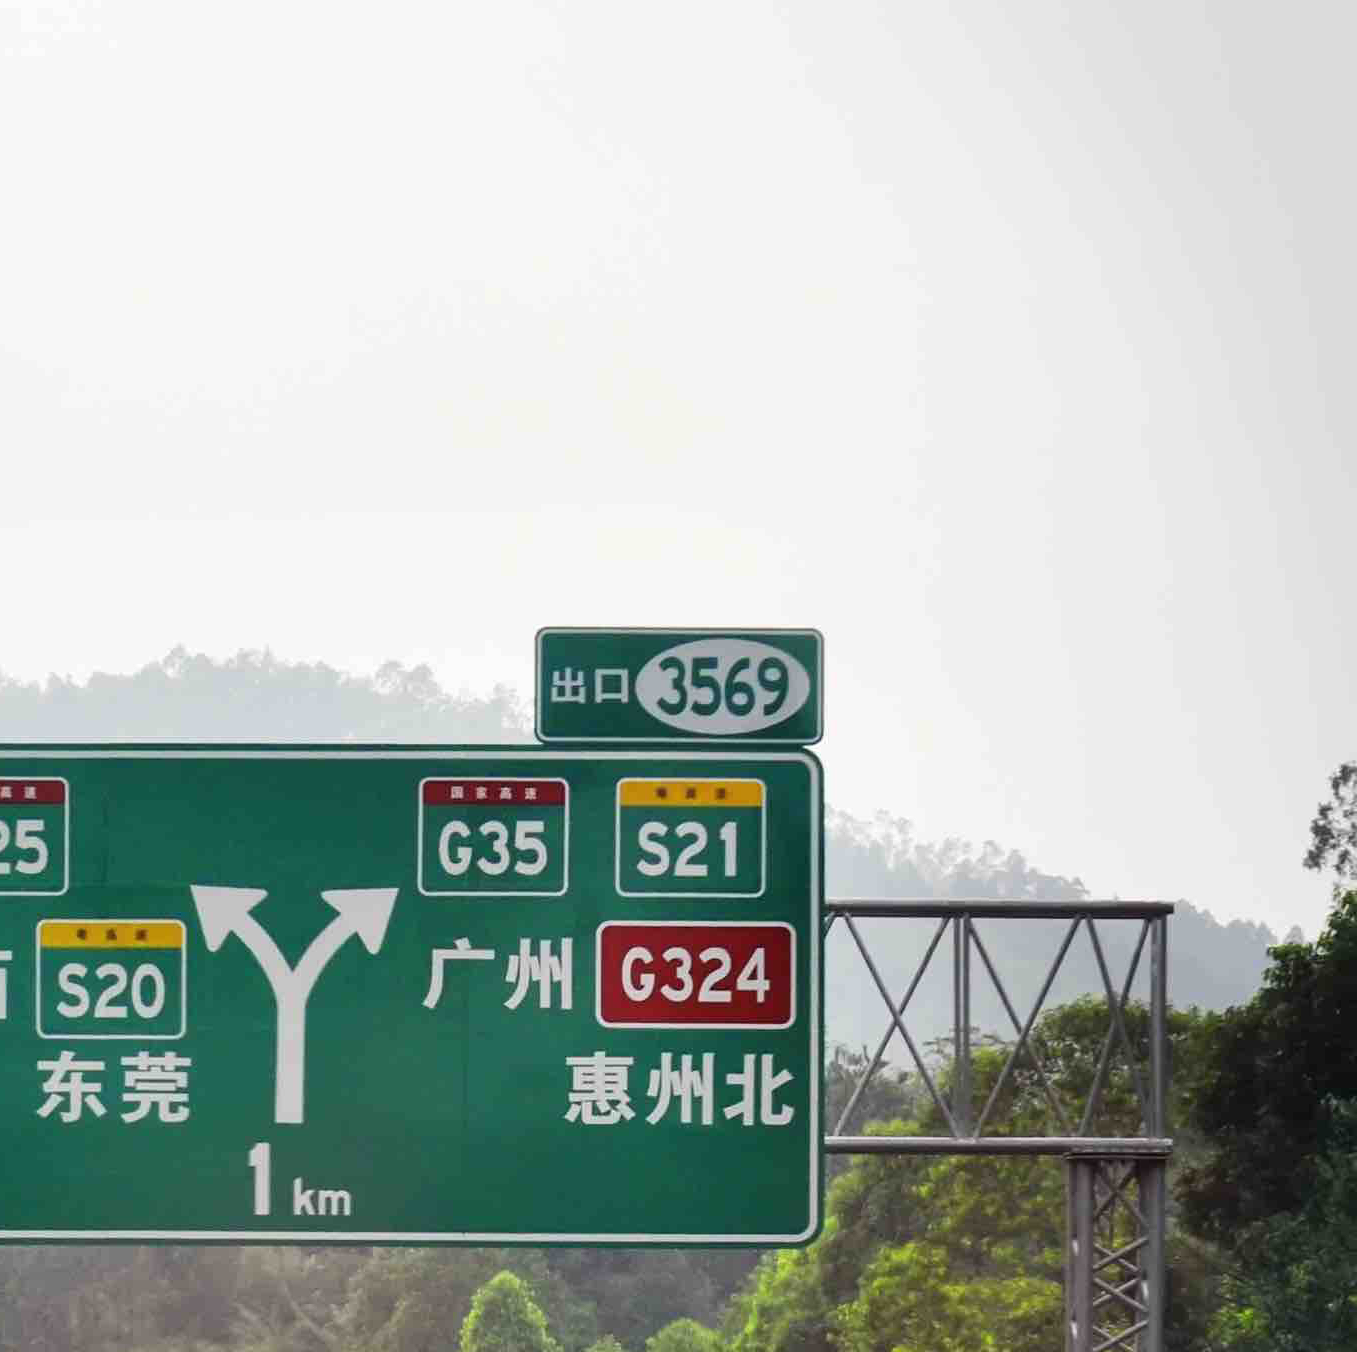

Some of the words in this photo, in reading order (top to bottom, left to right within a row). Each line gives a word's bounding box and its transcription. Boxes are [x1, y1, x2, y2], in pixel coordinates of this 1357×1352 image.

[551, 667, 630, 704] 出口
[656, 656, 790, 717] 3569
[438, 820, 548, 876] G35
[636, 821, 738, 877] S21
[56, 962, 166, 1019] S20
[421, 937, 574, 1010] 广州
[621, 946, 771, 1003] G324
[36, 1050, 192, 1123] 东莞
[564, 1050, 795, 1126] 惠州北
[248, 1142, 271, 1216] 1
[292, 1177, 352, 1216] km
